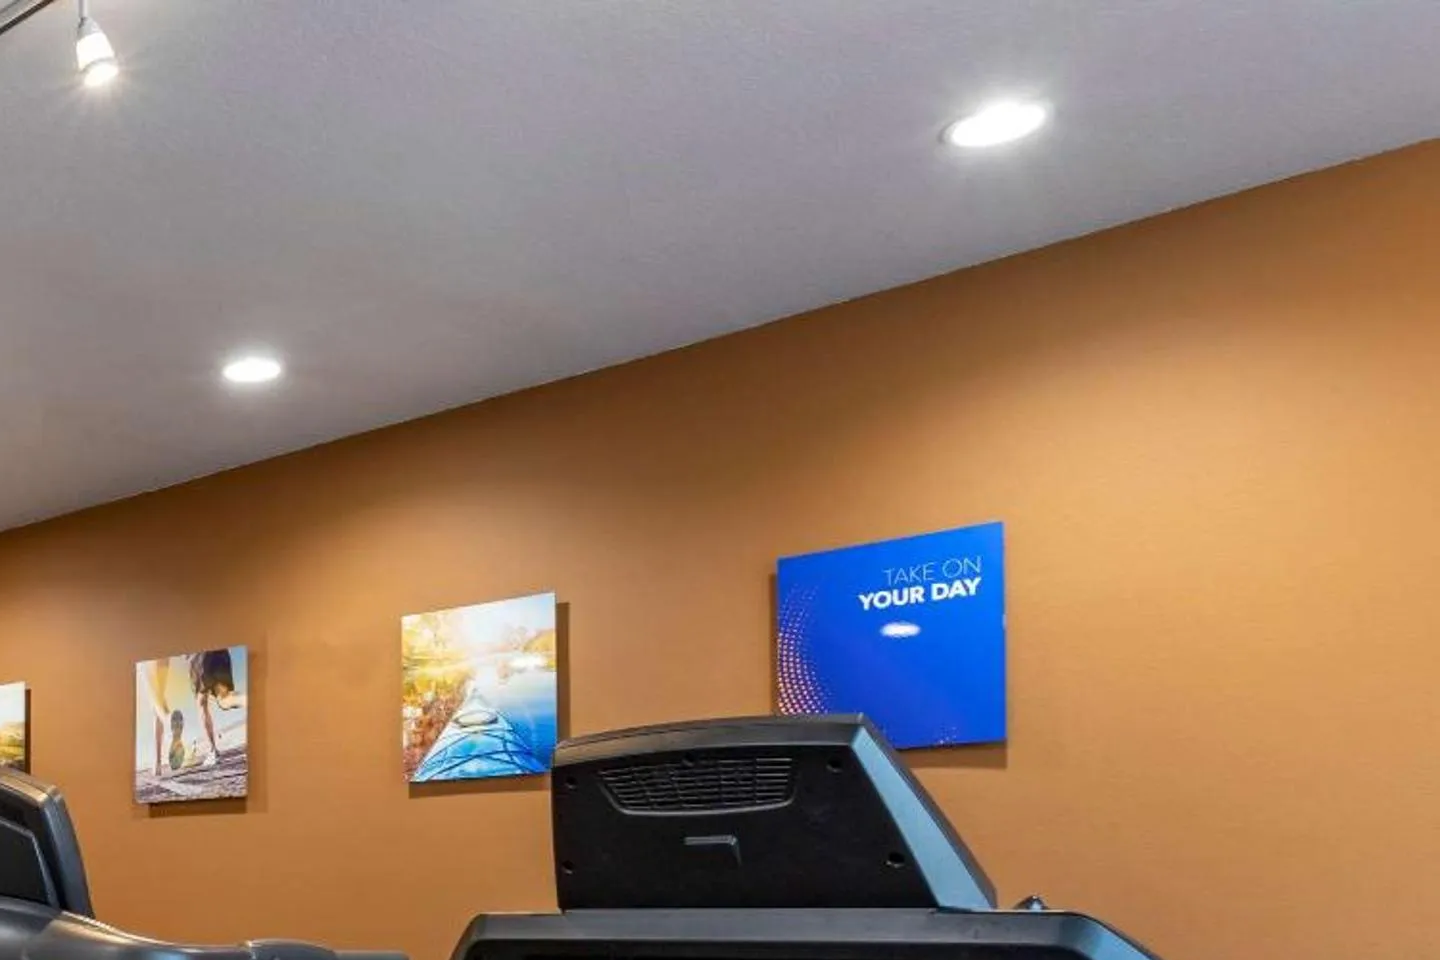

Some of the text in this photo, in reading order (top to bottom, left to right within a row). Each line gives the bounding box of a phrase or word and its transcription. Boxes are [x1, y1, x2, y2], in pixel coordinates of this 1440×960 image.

[883, 556, 982, 586] TAKE ON
[858, 577, 981, 611] YOUR DAY
